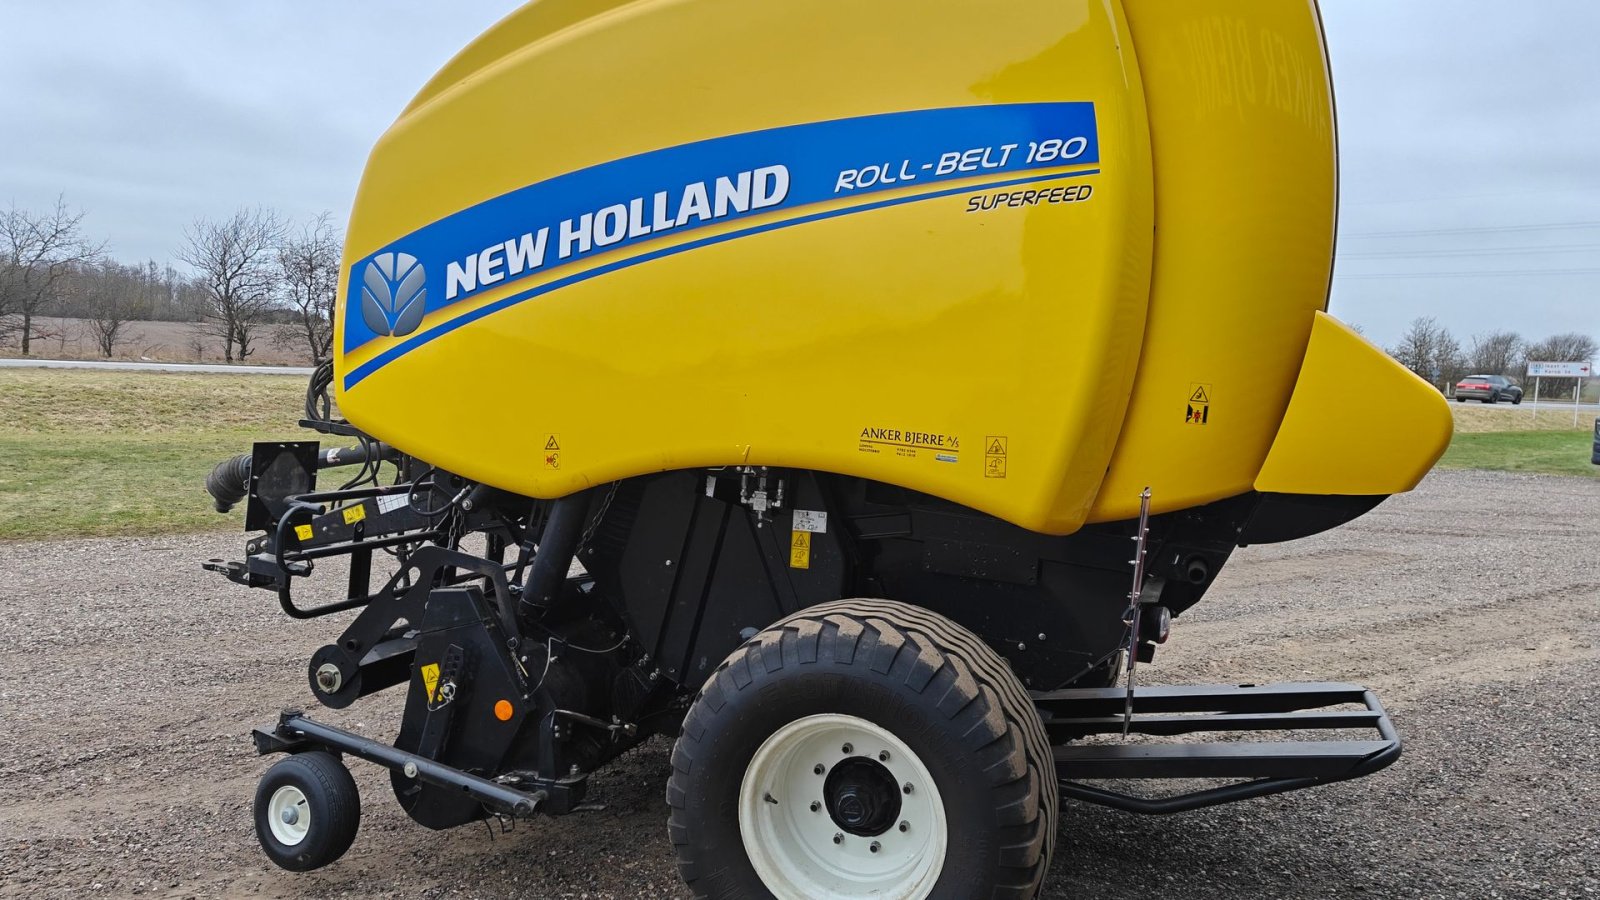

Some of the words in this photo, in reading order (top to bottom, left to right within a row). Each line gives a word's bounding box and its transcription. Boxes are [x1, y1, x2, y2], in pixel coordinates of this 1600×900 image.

[1026, 136, 1088, 163] 180
[966, 185, 1093, 212] SUPERFEED
[446, 227, 549, 300] NEW
[558, 164, 790, 260] HOLLAND
[860, 427, 901, 441] ANKER
[904, 431, 945, 446] BJERRE
[946, 435, 960, 448] A/S
